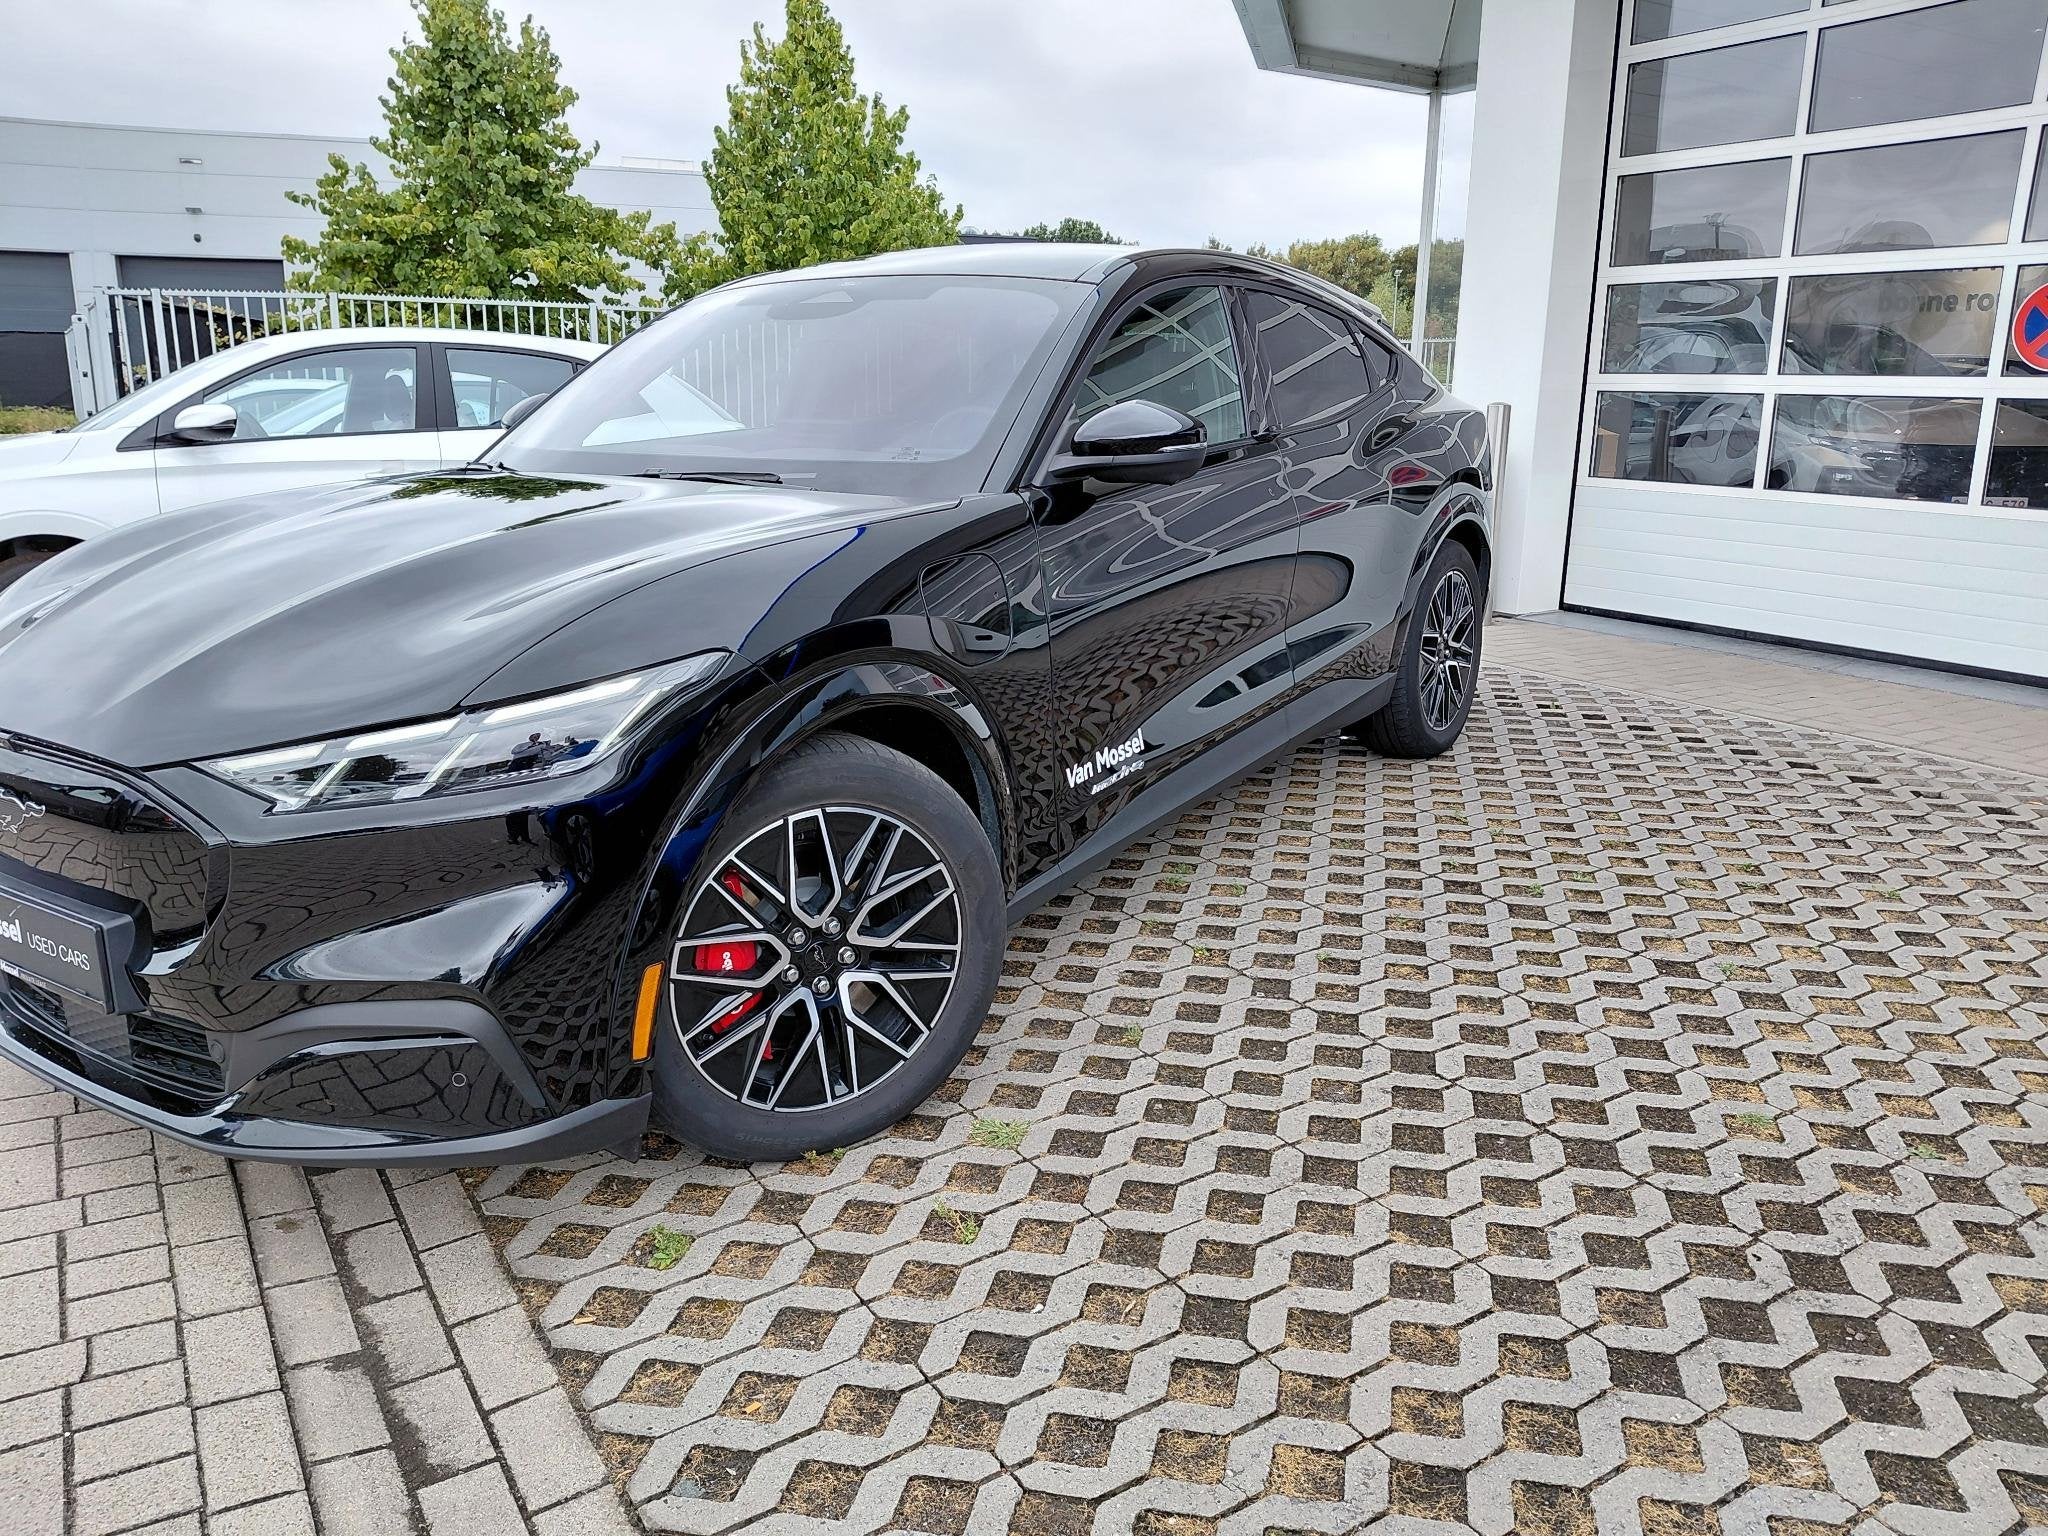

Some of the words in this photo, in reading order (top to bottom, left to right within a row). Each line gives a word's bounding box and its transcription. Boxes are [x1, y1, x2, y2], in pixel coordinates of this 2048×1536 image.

[1065, 761, 1094, 789] Van
[1095, 727, 1145, 774] Mossel
[27, 931, 57, 957] USED
[58, 945, 91, 971] CARS
